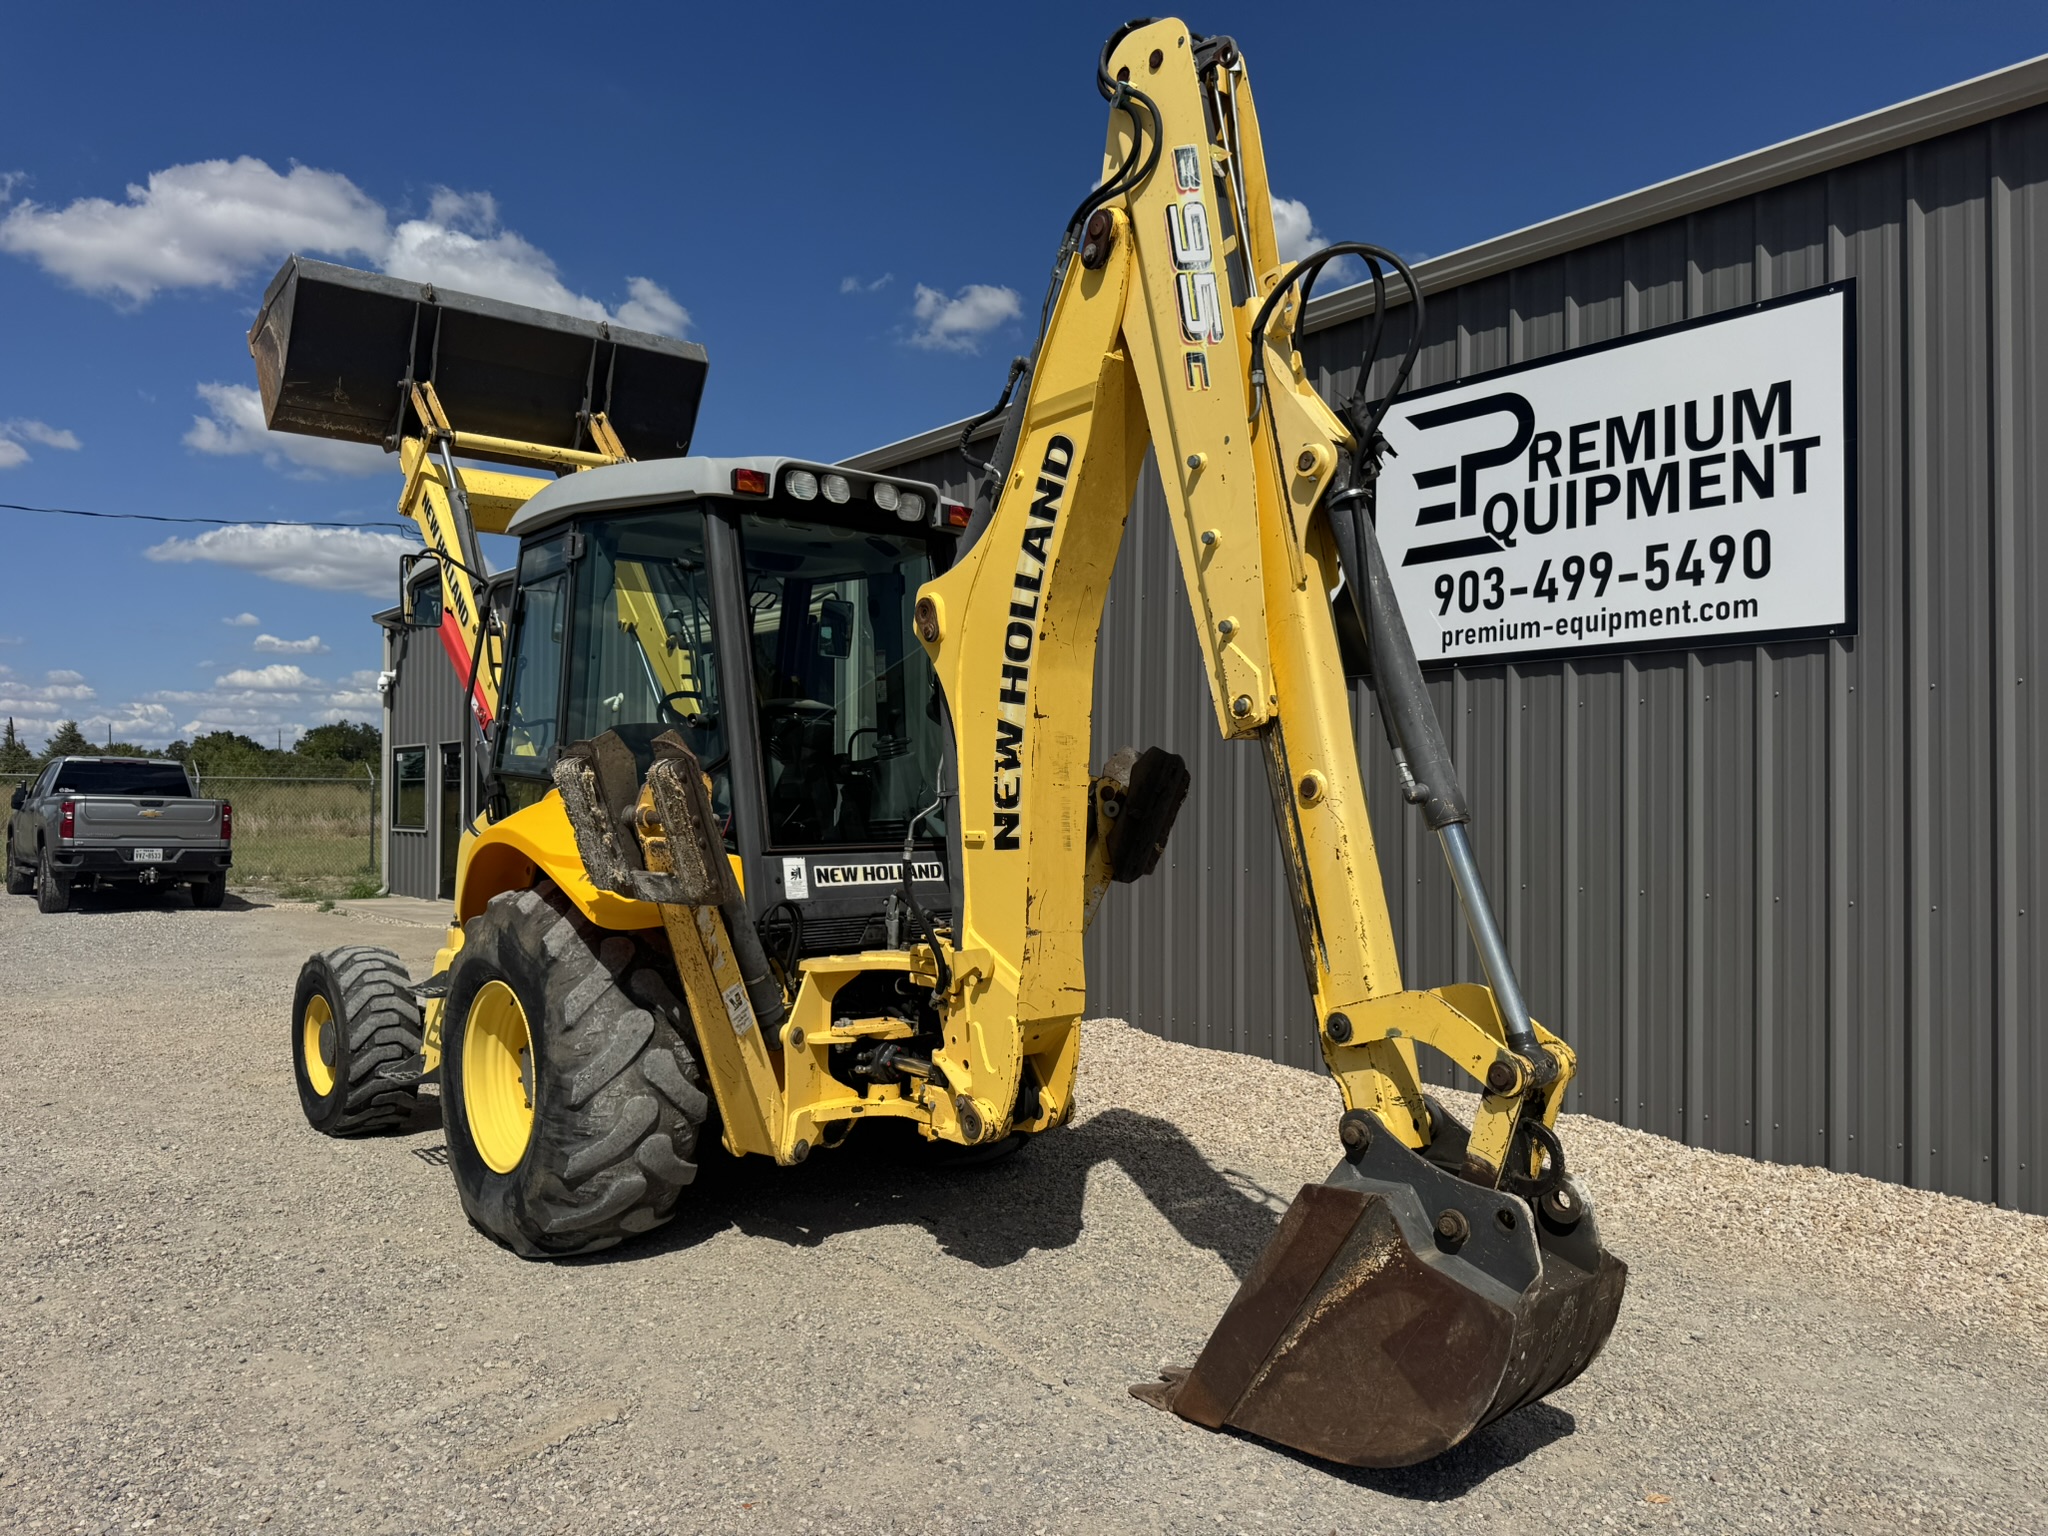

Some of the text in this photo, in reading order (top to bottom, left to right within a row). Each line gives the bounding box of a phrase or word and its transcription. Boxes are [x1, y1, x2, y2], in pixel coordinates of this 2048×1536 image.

[422, 491, 439, 539] NEW
[1000, 433, 1075, 706] HOLLAND
[1434, 528, 1772, 617] 903-499-5490
[1441, 594, 1759, 653] premium-equipment.com
[993, 718, 1023, 850] NEW
[816, 863, 942, 884] NEW HOLLAND
